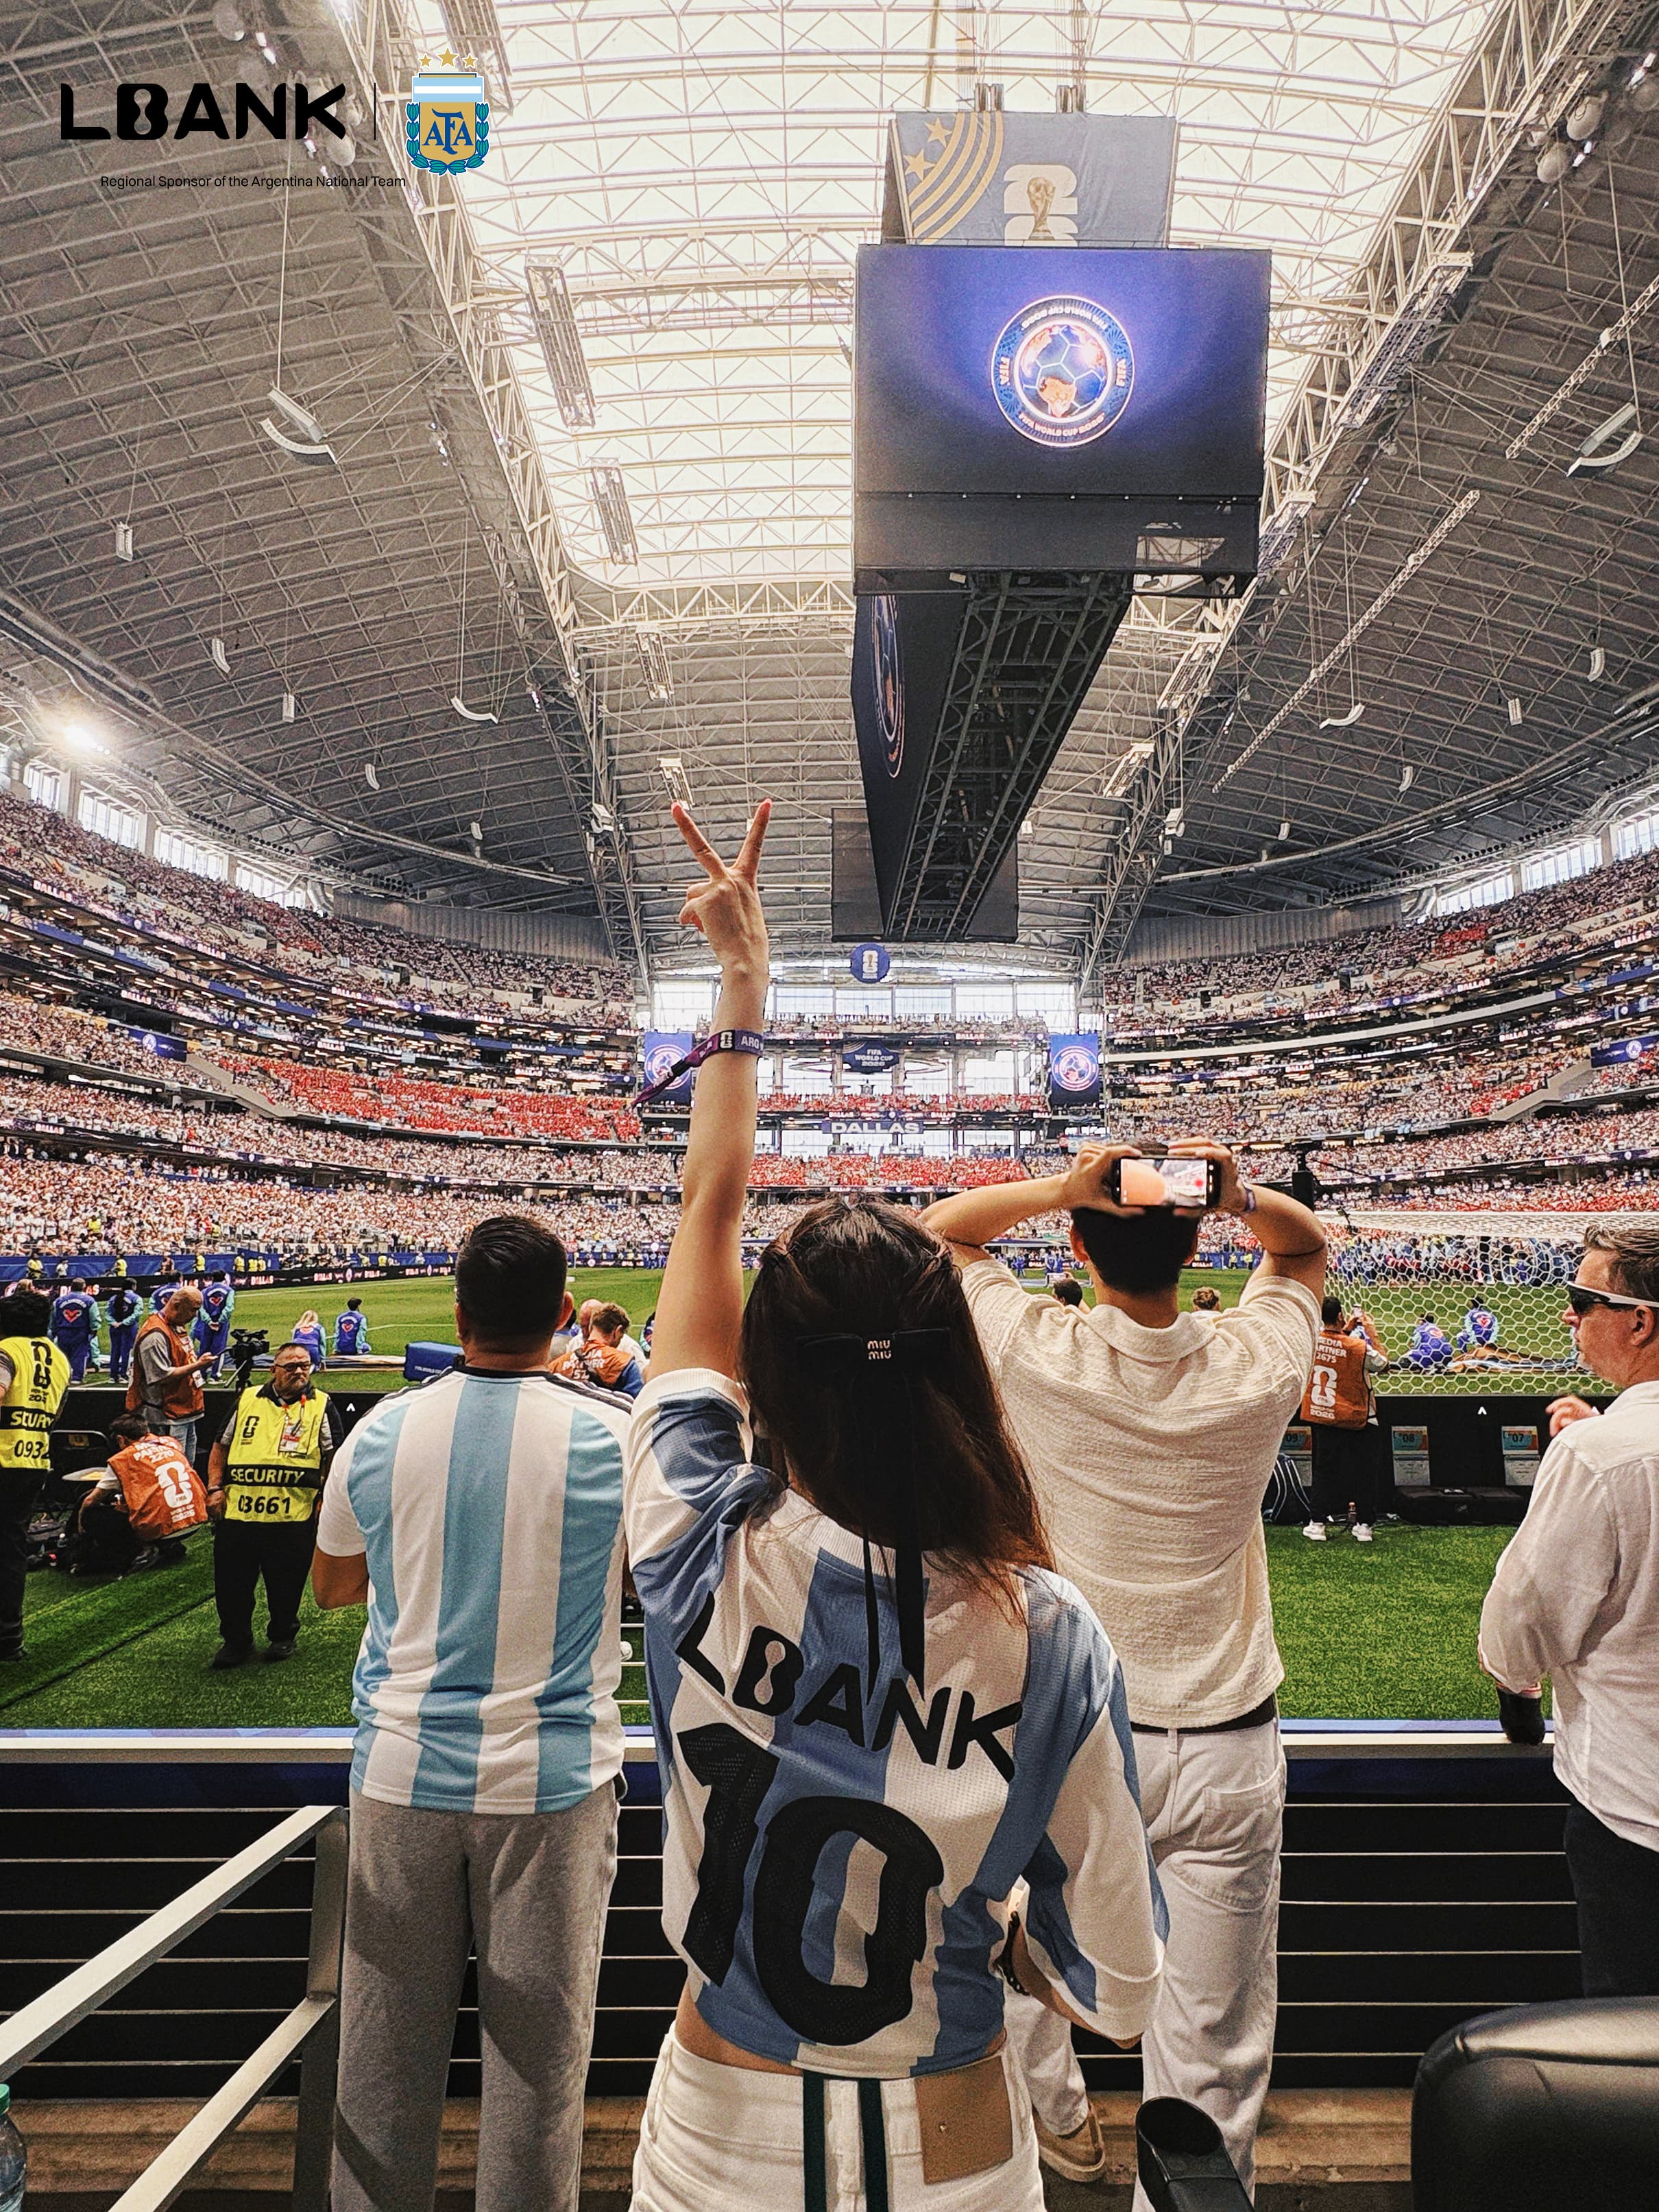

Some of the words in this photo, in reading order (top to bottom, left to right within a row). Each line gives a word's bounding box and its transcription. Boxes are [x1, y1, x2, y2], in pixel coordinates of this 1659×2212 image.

[33, 880, 73, 902] DALLAS
[1614, 930, 1653, 948] DALLAS
[1457, 978, 1490, 992] DALLAS
[1304, 1009, 1335, 1020] DALLAS
[741, 1035, 760, 1049] ARG
[1499, 1030, 1528, 1042] DALLAS
[512, 1044, 546, 1053] DALLAS
[831, 1122, 919, 1133] DALLAS
[1318, 1336, 1343, 1349] EDIA
[1316, 1345, 1347, 1358] RTNER
[1512, 1432, 1524, 1443] 07
[230, 1468, 306, 1484] SECURITY
[238, 1494, 291, 1514] 03661
[675, 1591, 1024, 1784] LBANK
[677, 1722, 945, 2047] 10
